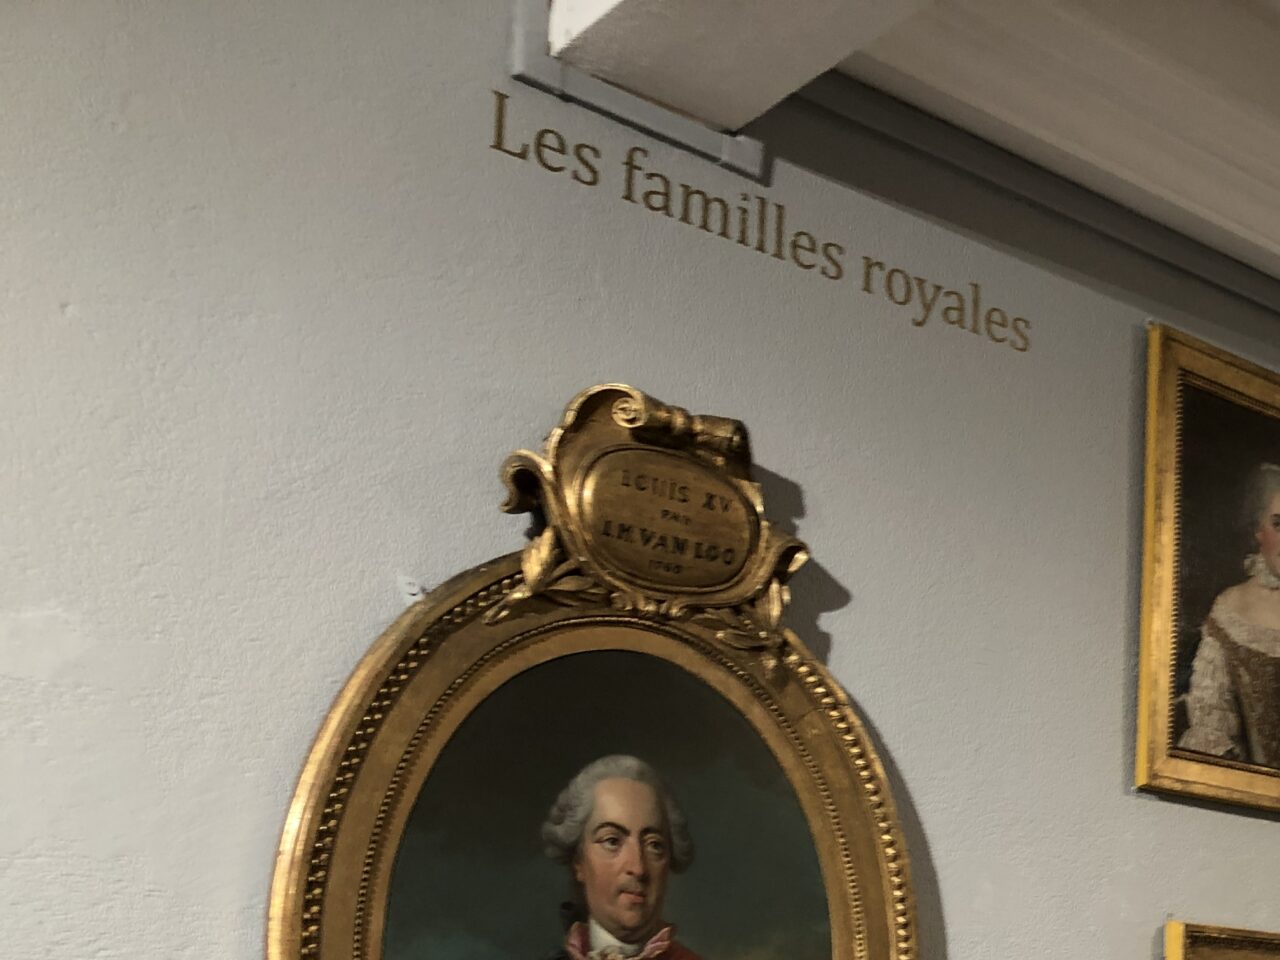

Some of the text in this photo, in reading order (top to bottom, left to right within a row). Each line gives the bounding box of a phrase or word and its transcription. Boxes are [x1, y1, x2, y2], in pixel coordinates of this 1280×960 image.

[489, 90, 1033, 354] Les familles royales
